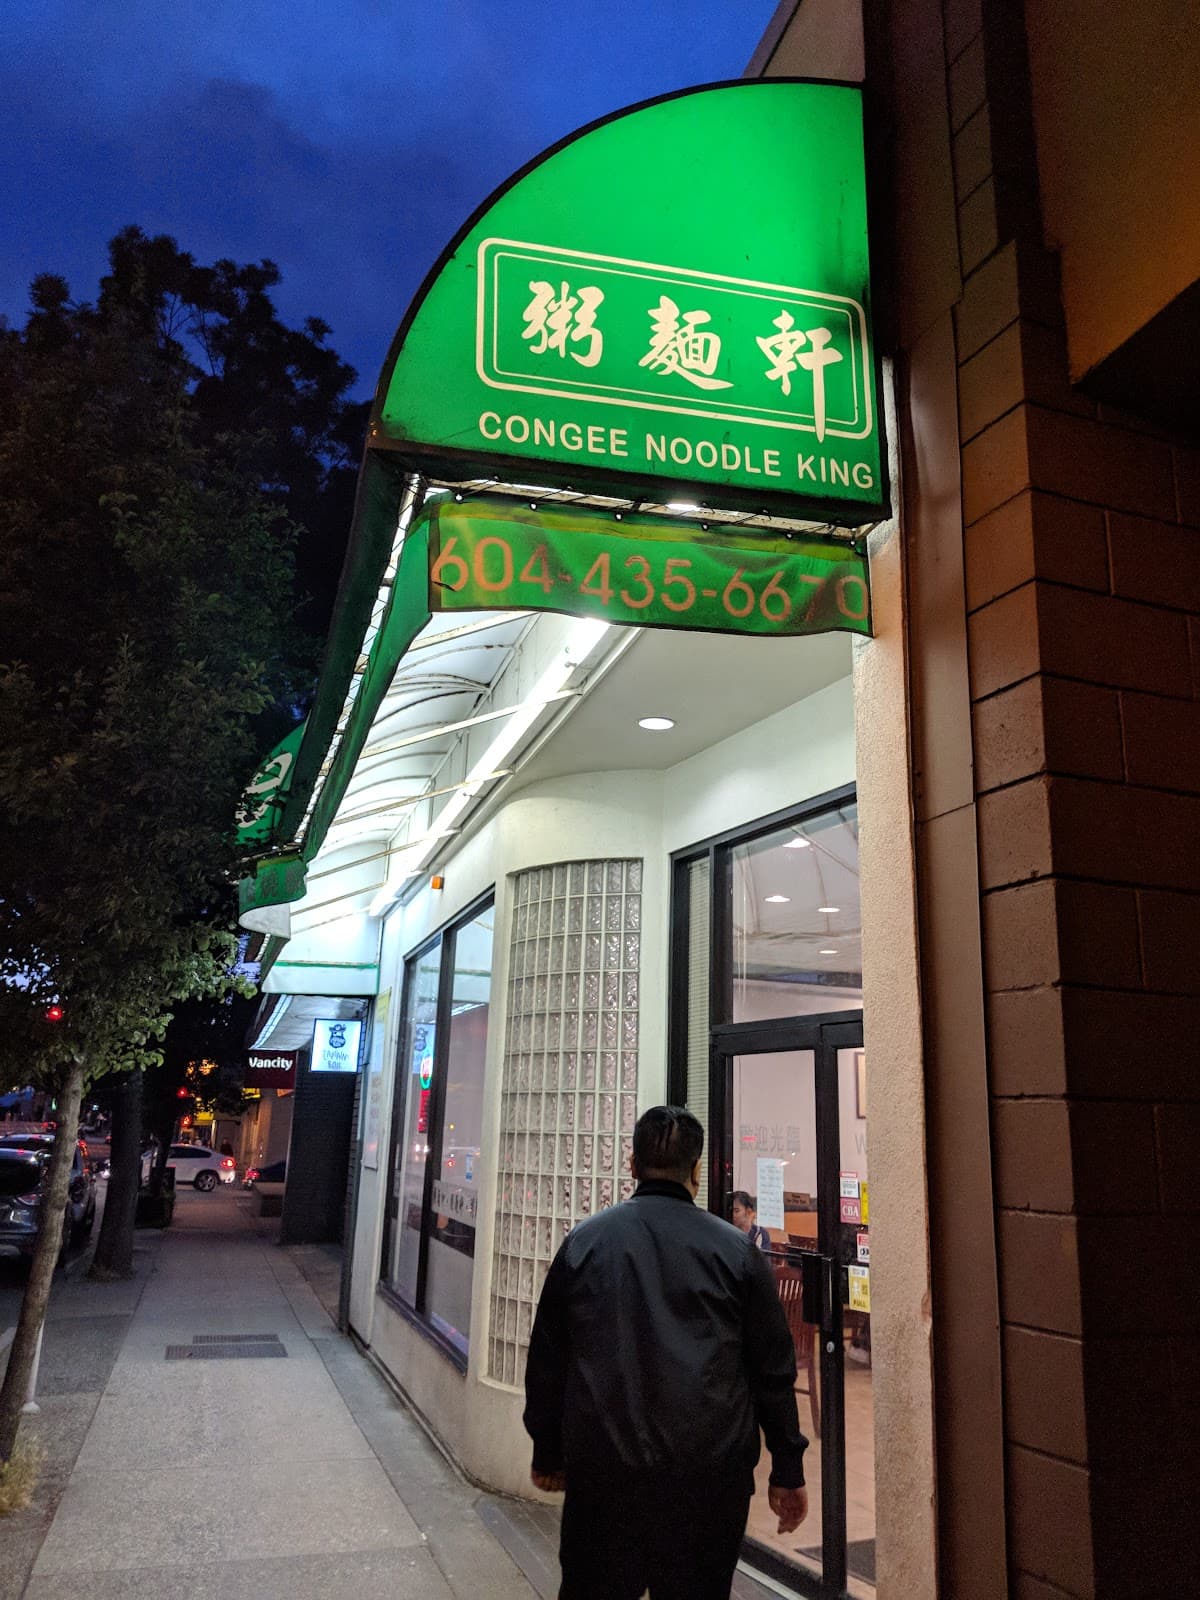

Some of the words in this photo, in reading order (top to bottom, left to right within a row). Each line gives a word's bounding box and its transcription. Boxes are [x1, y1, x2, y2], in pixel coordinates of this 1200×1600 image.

[521, 280, 845, 443] 粥麵軒
[478, 410, 629, 457] CONGEE
[645, 433, 781, 478] NOODLE
[796, 453, 874, 489] KING
[430, 536, 868, 622] 604-435-6670
[248, 1056, 293, 1073] Vancity
[842, 1205, 859, 1217] CBA
